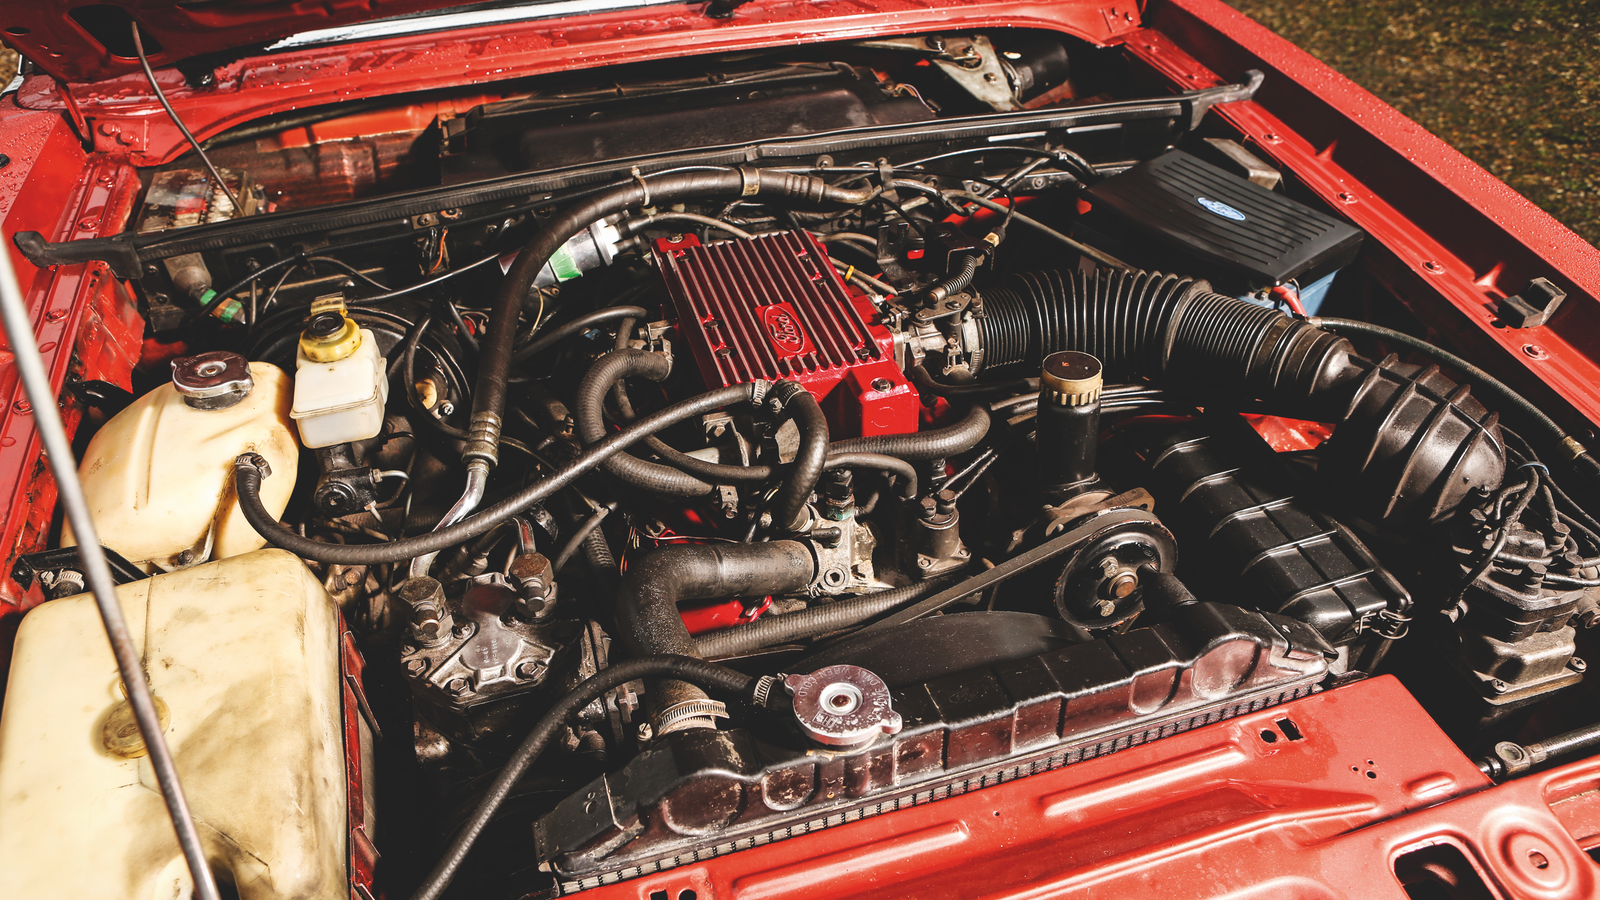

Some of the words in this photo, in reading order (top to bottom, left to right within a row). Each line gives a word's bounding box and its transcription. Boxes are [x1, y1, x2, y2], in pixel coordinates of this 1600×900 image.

[769, 313, 800, 344] Ford
[818, 667, 851, 679] WHEN
[857, 669, 880, 686] ONLY
[798, 676, 817, 697] COLD
